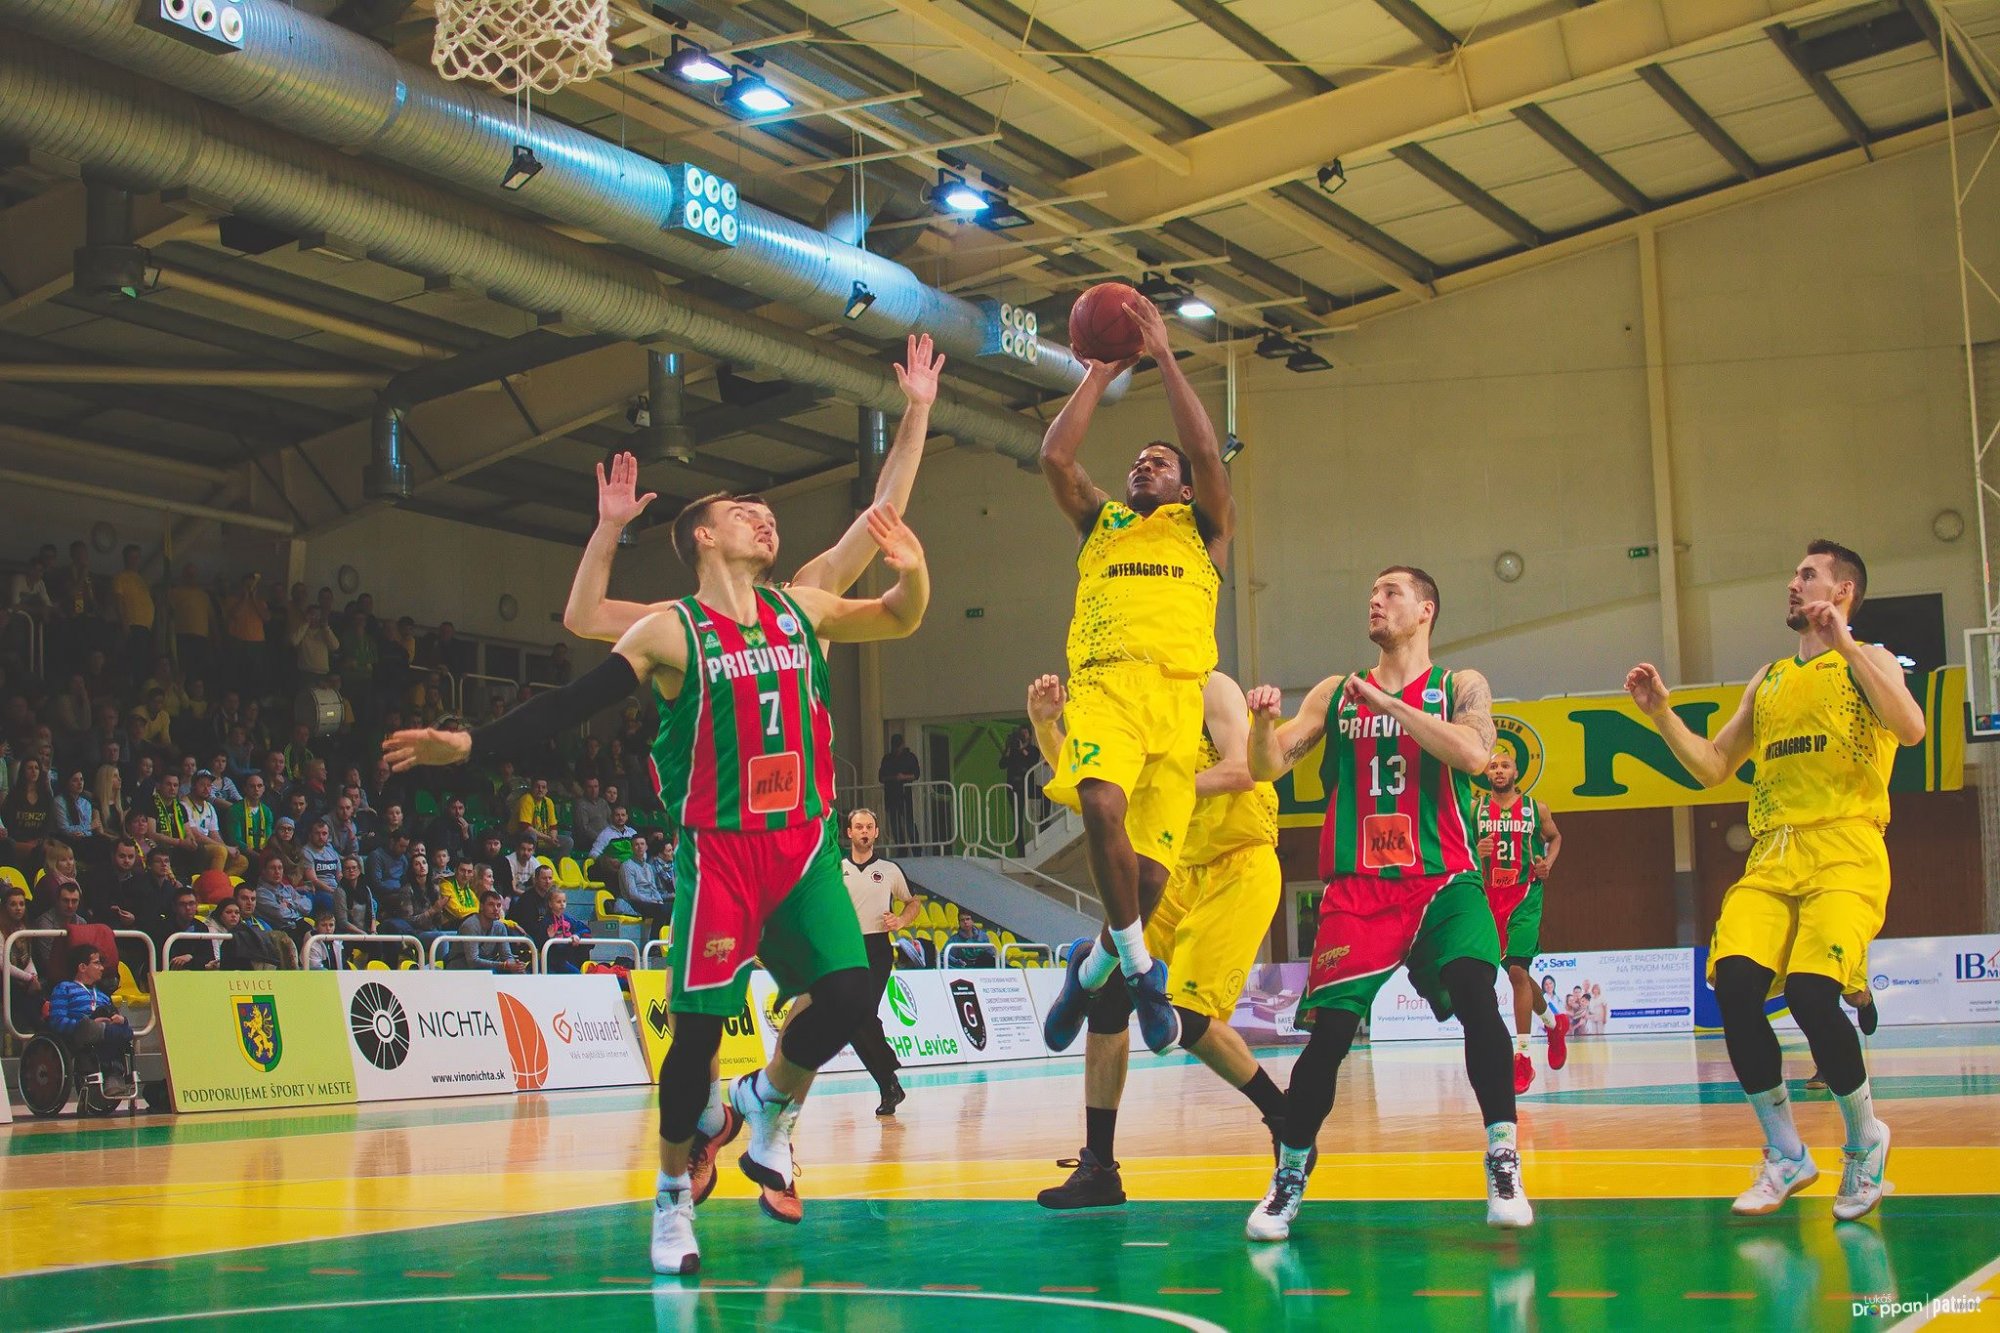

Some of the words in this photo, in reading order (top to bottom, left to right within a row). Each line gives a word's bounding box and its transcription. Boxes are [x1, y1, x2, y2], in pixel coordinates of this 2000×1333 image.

[1108, 562, 1168, 578] INTERAGROS
[1171, 566, 1184, 579] VP
[706, 644, 806, 683] PRIEVIDZA
[759, 691, 780, 736] 7
[1814, 734, 1827, 752] VP
[756, 769, 793, 795] niké
[1369, 755, 1407, 797] 13
[1371, 826, 1406, 851] niké
[1479, 819, 1533, 834] PRIEVIDZA
[1496, 840, 1516, 861] 21
[1956, 953, 1986, 979] IB
[229, 980, 273, 991] LEVICE
[417, 1011, 498, 1038] NICHTA
[574, 1012, 624, 1042] slovanet
[964, 1001, 978, 1028] G
[914, 1033, 958, 1057] Levice
[431, 1070, 506, 1083] www.vinonichta.sk
[182, 1086, 268, 1103] PODPORUJEME
[270, 1083, 305, 1099] ŠPORT
[307, 1083, 318, 1096] V
[318, 1081, 353, 1095] MESTE
